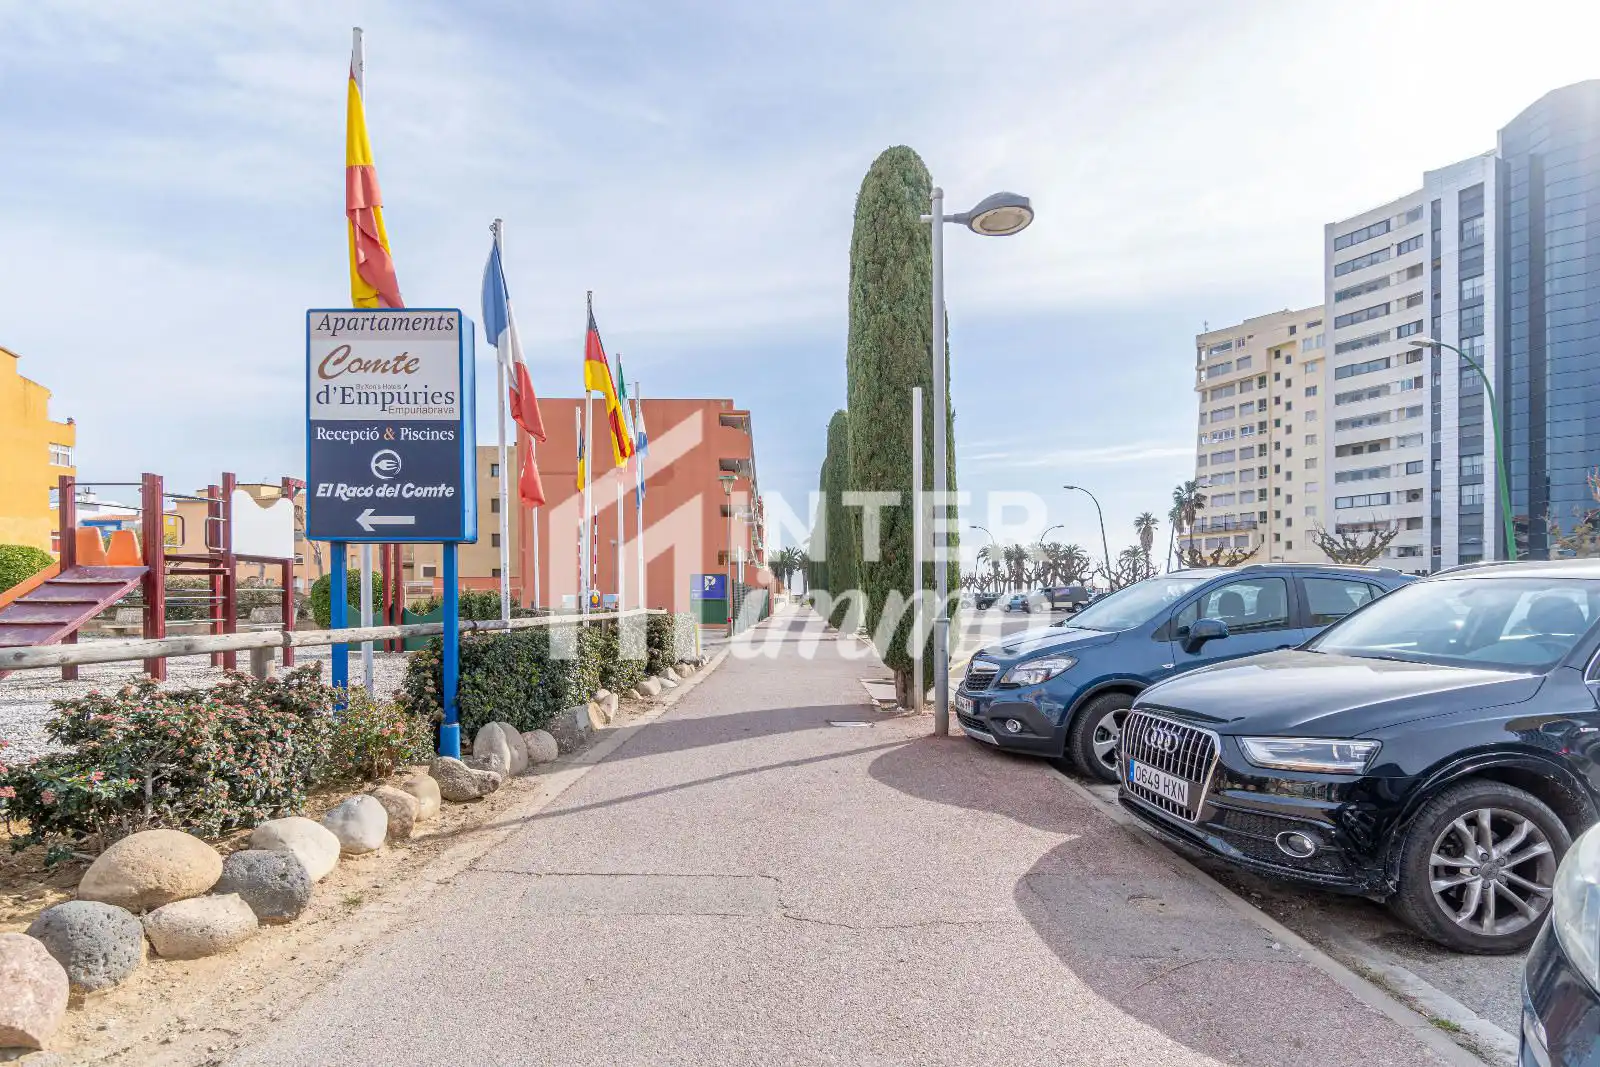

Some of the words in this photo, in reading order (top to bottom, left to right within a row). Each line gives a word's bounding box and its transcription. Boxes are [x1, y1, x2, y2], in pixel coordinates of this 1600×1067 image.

[316, 313, 455, 337] Apartaments
[317, 344, 421, 381] Comte
[316, 384, 455, 412] d'Empúries
[388, 405, 455, 416] Empuriabrava
[316, 426, 380, 445] Recepció
[383, 426, 395, 441] &
[400, 427, 455, 441] Piscines
[316, 483, 334, 497] El
[334, 483, 374, 501] Racó
[375, 483, 401, 498] del
[401, 482, 455, 498] Comte
[704, 575, 717, 591] P
[1135, 765, 1160, 790] 0649
[1163, 776, 1186, 802] HXN
